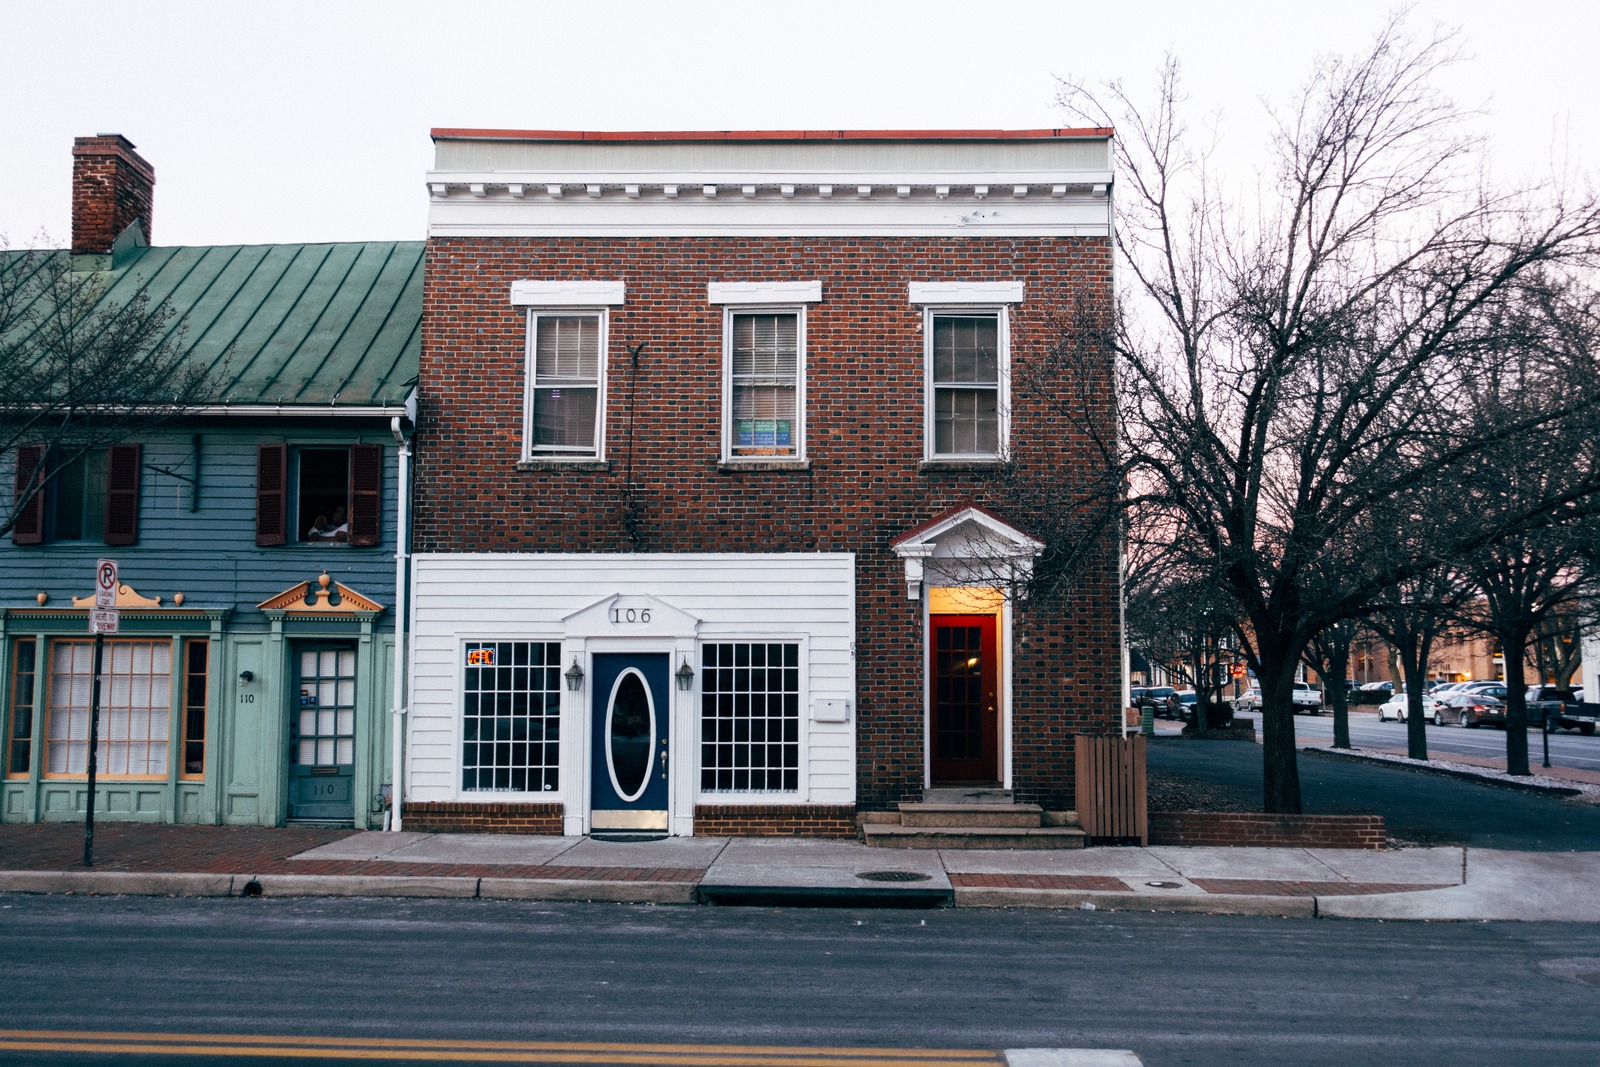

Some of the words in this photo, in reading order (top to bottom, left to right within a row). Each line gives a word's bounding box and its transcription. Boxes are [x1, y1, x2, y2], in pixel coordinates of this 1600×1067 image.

[95, 612, 107, 621] HERE
[109, 613, 115, 622] TO
[615, 608, 651, 623] 106
[93, 621, 116, 631] RIVEWAY
[240, 694, 255, 704] 110
[314, 784, 335, 795] 110
